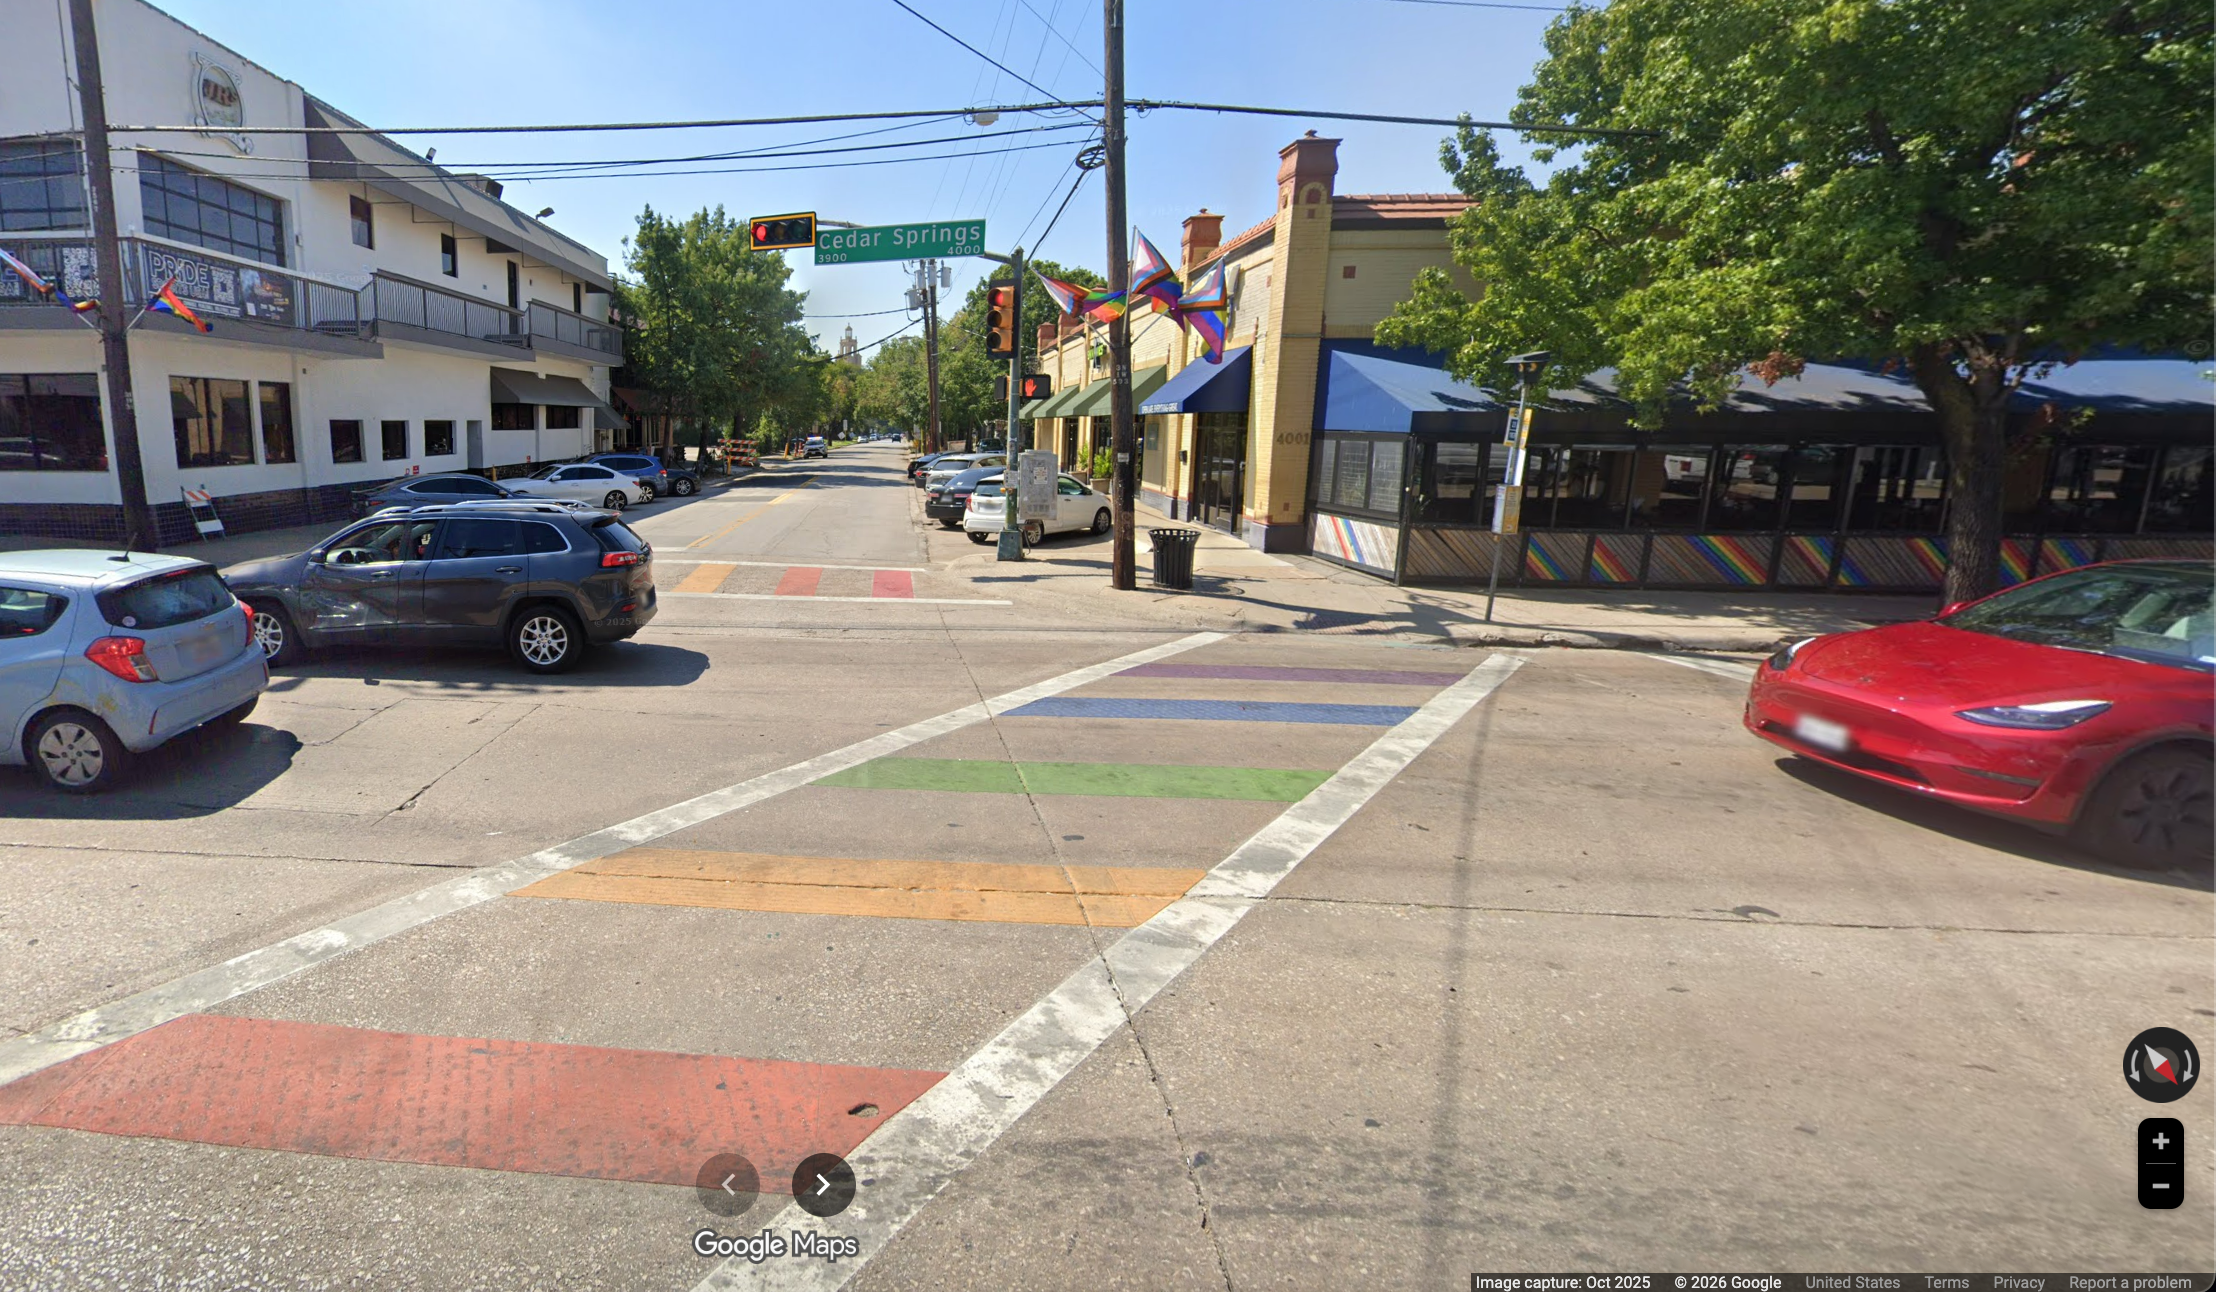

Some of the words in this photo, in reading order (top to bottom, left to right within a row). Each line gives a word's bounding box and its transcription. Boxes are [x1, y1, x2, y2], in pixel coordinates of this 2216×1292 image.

[819, 231, 882, 250] Cedar
[892, 224, 981, 248] Springs
[947, 245, 981, 255] 4000
[818, 253, 847, 263] 3900
[1276, 432, 1310, 445] 4001
